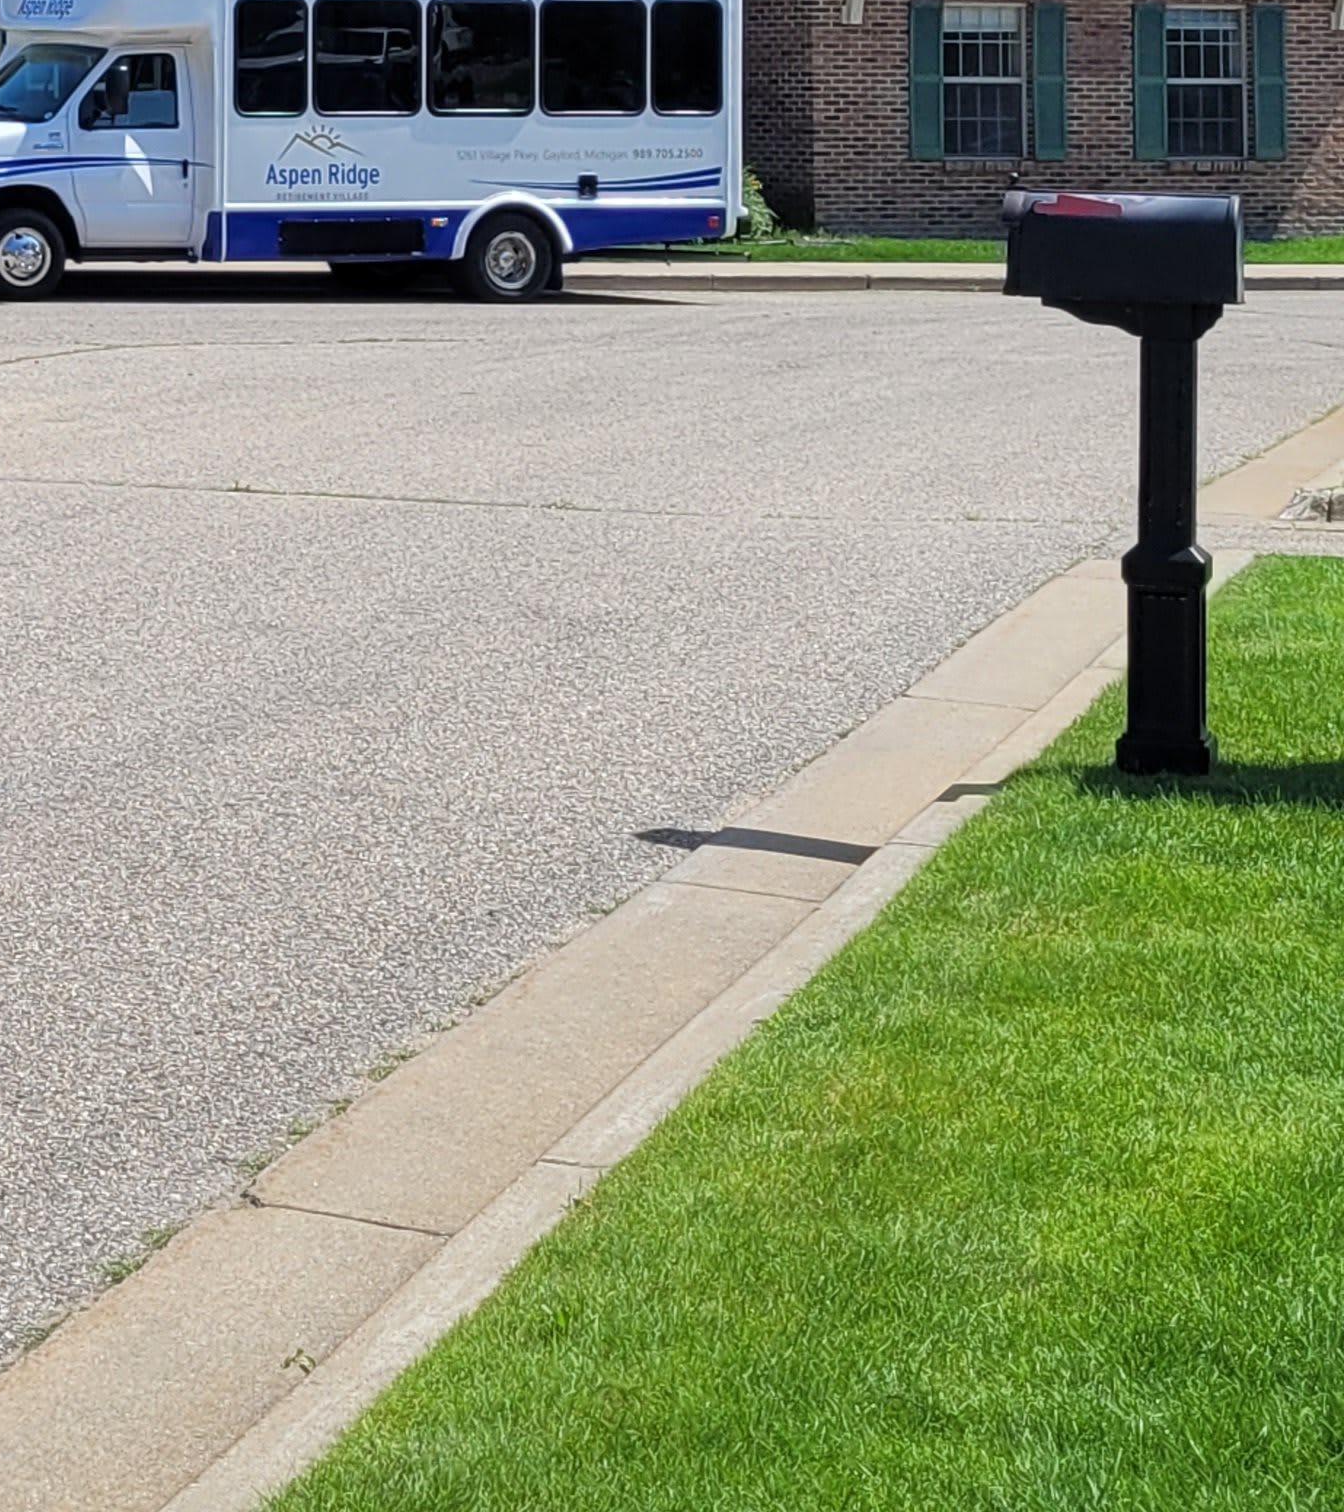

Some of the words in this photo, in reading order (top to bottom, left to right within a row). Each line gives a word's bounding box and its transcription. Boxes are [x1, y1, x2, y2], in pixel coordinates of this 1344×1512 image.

[480, 150, 511, 164] Village
[633, 148, 703, 160] 989.705.2500
[265, 163, 322, 189] Aspen
[328, 163, 380, 190] Ridge
[276, 192, 331, 201] RETIREMENT
[334, 192, 369, 201] VILLAGE
